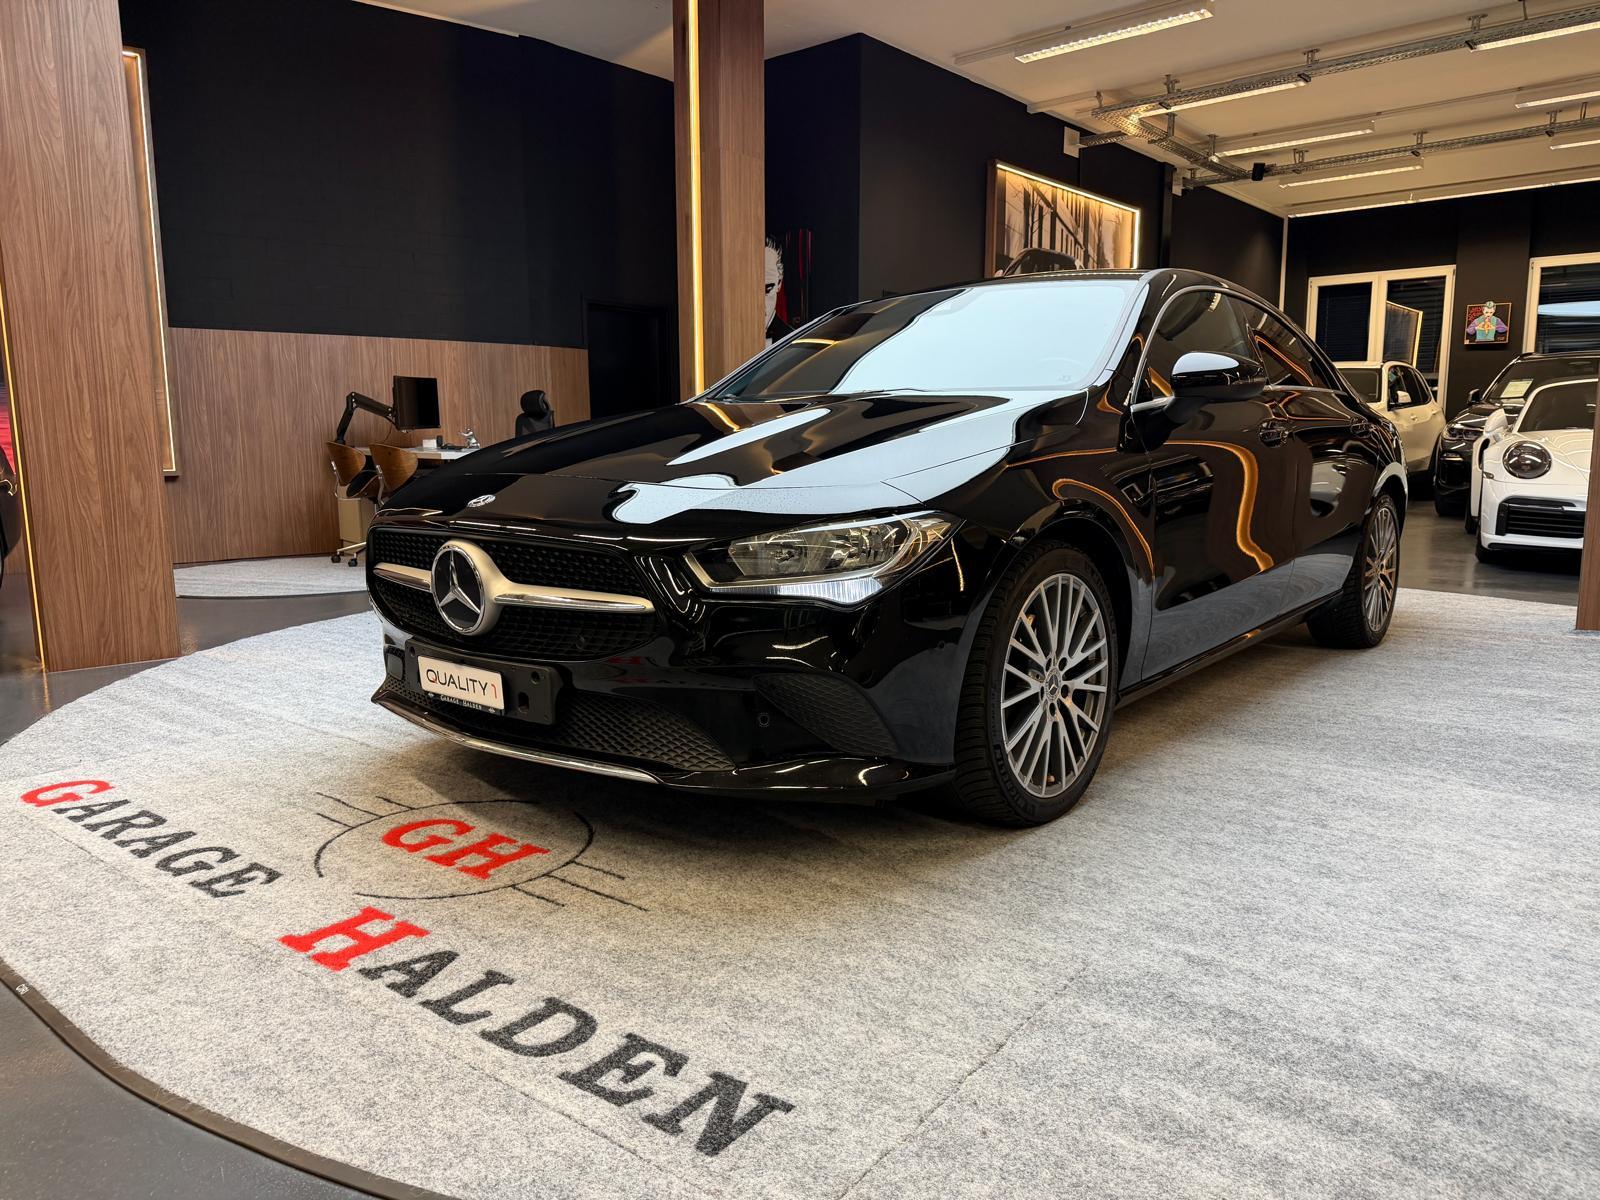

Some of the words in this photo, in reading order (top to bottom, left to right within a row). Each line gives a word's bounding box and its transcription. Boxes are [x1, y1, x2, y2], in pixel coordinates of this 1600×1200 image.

[22, 780, 282, 899] GARAGE
[380, 818, 551, 881] GH
[279, 906, 794, 1157] HALDEN
